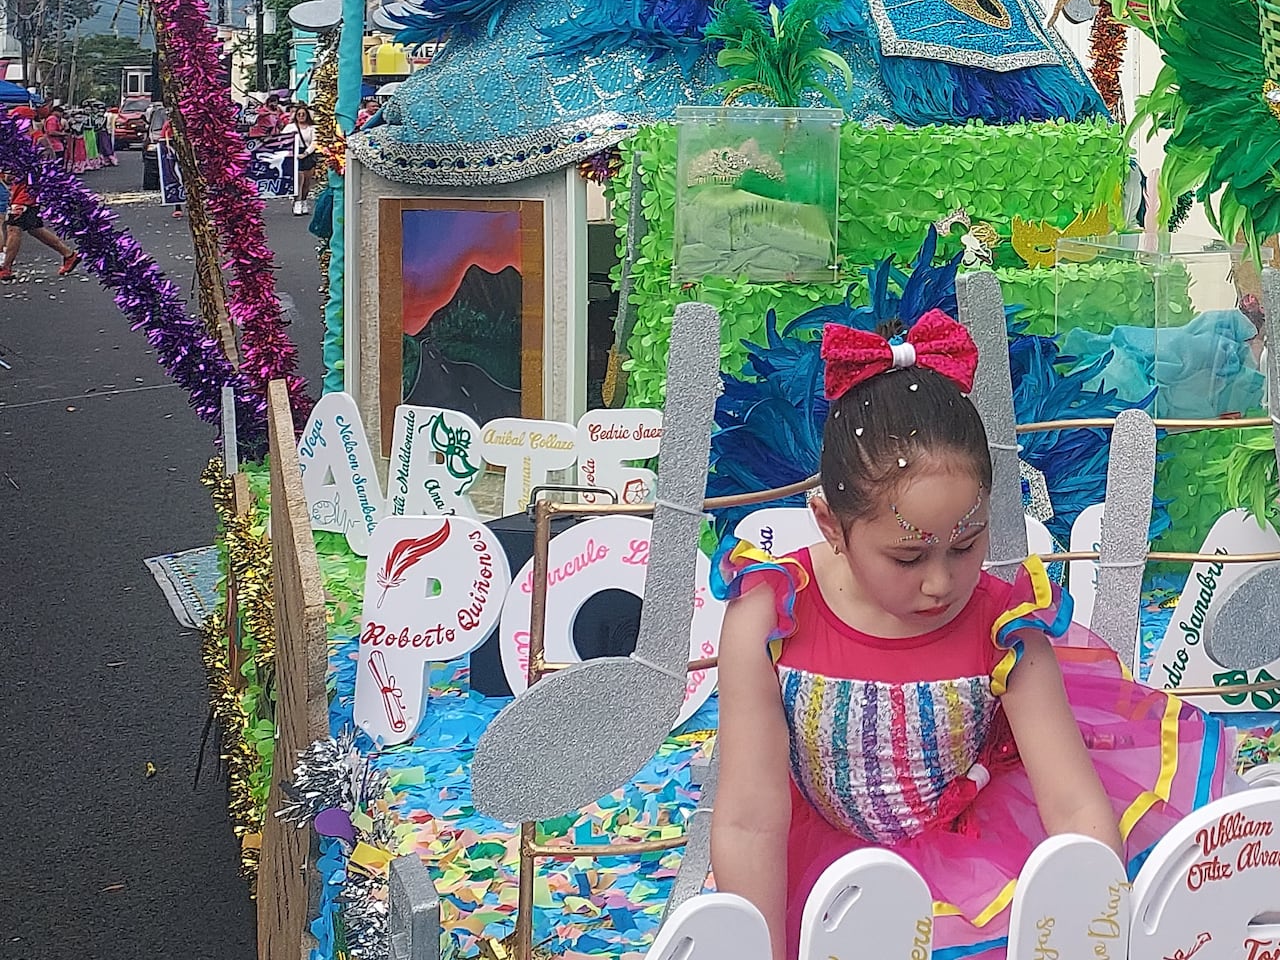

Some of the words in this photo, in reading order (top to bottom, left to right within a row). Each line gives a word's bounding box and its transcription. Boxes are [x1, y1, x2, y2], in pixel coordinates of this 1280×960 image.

[300, 418, 328, 458] Vega
[335, 414, 359, 471] Nelson
[396, 410, 416, 494] Maldonado
[588, 423, 631, 442] Cedric
[361, 622, 456, 648] Roberto
[457, 531, 493, 631] Quiñones
[1195, 812, 1273, 857] William
[1187, 858, 1232, 891] Ortiz
